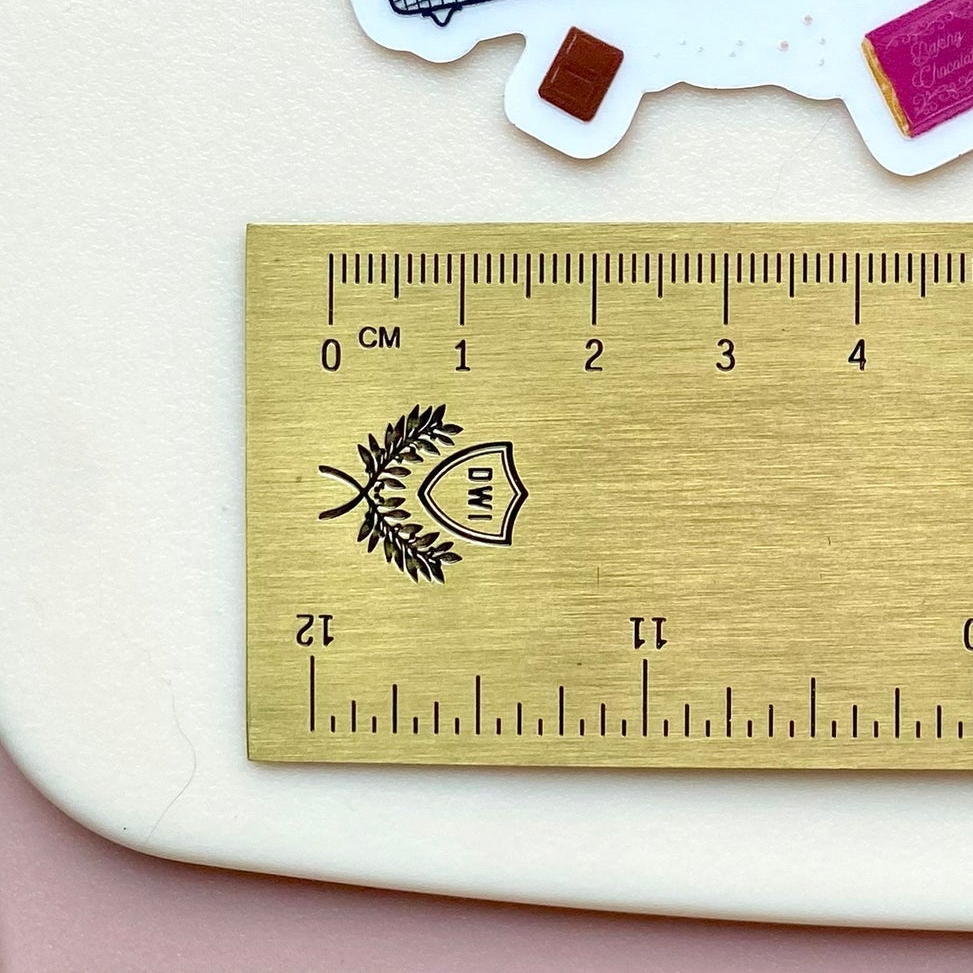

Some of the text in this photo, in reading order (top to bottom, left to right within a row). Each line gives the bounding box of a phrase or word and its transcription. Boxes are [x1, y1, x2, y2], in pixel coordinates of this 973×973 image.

[358, 326, 403, 349] CM
[321, 338, 342, 372] 0
[454, 339, 471, 372] 1
[584, 338, 604, 372] 2
[715, 338, 736, 372] 3
[847, 338, 867, 372] 4
[467, 467, 493, 521] DWI
[296, 614, 335, 647] 12
[629, 616, 668, 650] 11
